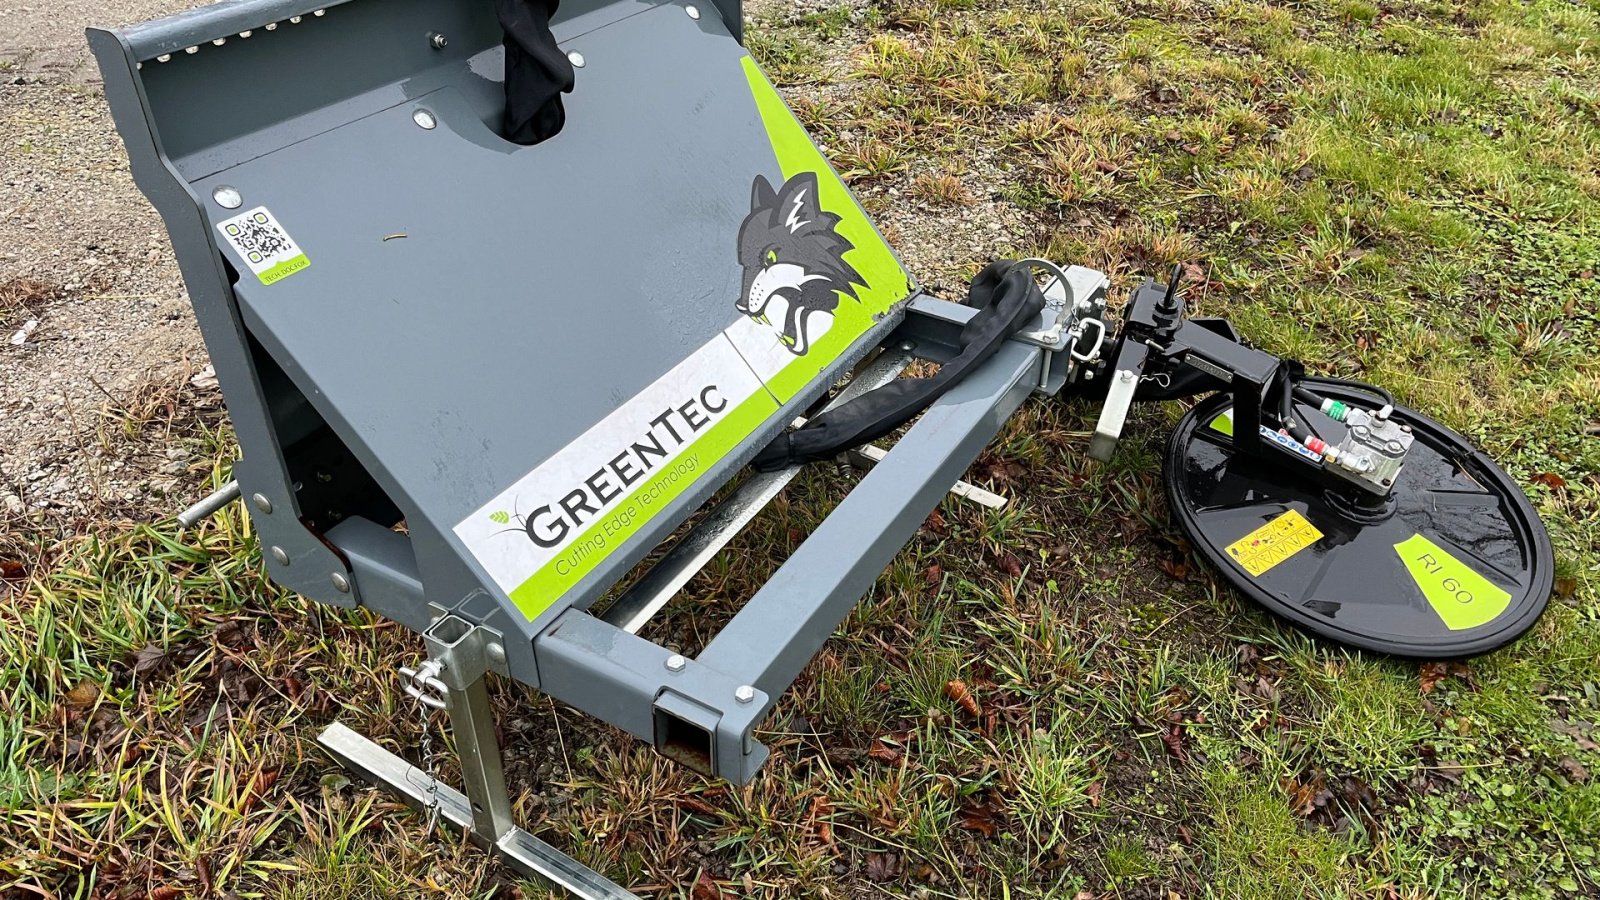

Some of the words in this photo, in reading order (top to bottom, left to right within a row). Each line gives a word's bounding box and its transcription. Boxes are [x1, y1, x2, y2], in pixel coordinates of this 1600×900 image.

[556, 533, 606, 576] Cutting
[602, 506, 637, 537] Edge
[634, 453, 699, 509] Technology
[1417, 553, 1443, 574] RI
[1442, 578, 1473, 604] 60
